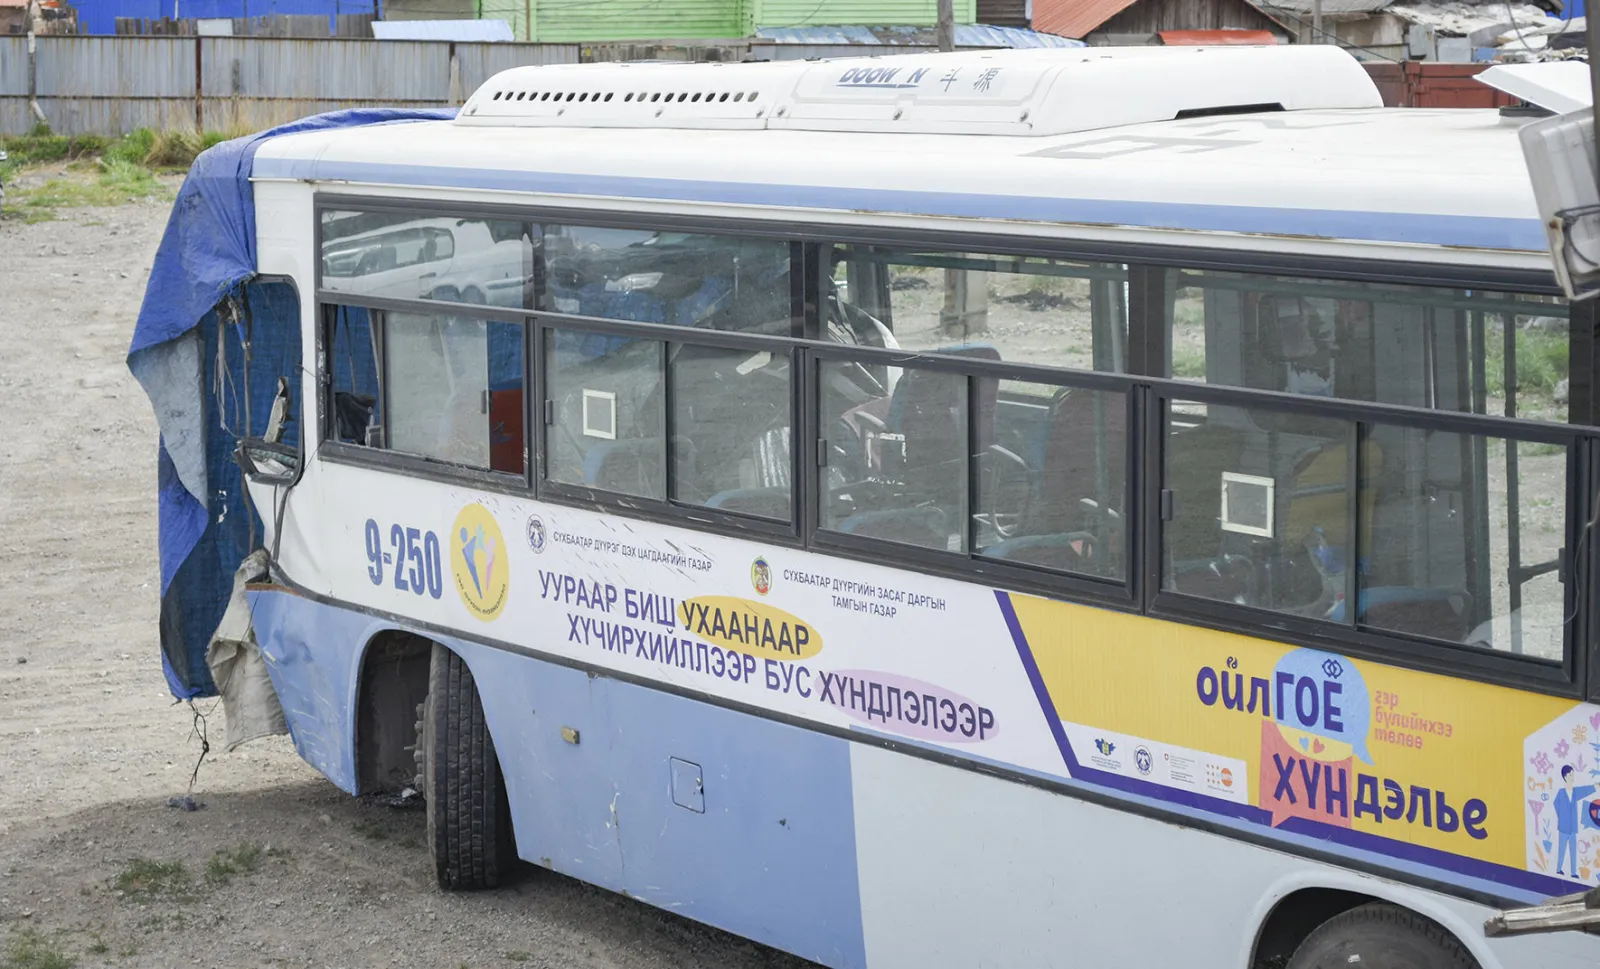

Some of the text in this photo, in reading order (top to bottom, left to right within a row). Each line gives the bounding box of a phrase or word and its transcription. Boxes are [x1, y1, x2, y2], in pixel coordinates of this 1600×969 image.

[365, 518, 442, 599] 9-250
[553, 531, 593, 548] СҮХБААТАР
[621, 545, 636, 558] ДЭХ
[637, 549, 687, 567] ЦАГДААГИЙН
[688, 557, 712, 572] ГАЗАР
[783, 569, 946, 611] СҮХБААТАР ДҮҮРГИЙН ЗАСАГ ДАРГЫН
[831, 595, 897, 618] ТАМГЫН ГАЗАР
[538, 569, 617, 613] УУРААР
[624, 588, 676, 627] БИШ
[682, 600, 810, 656] УХААНААР
[567, 613, 995, 740] ХҮЧИРХИЙЛЛЭЭР БУС ХҮНДЛЭЛЭЭР
[1375, 690, 1399, 710] гэр
[1375, 728, 1423, 750] төлөө
